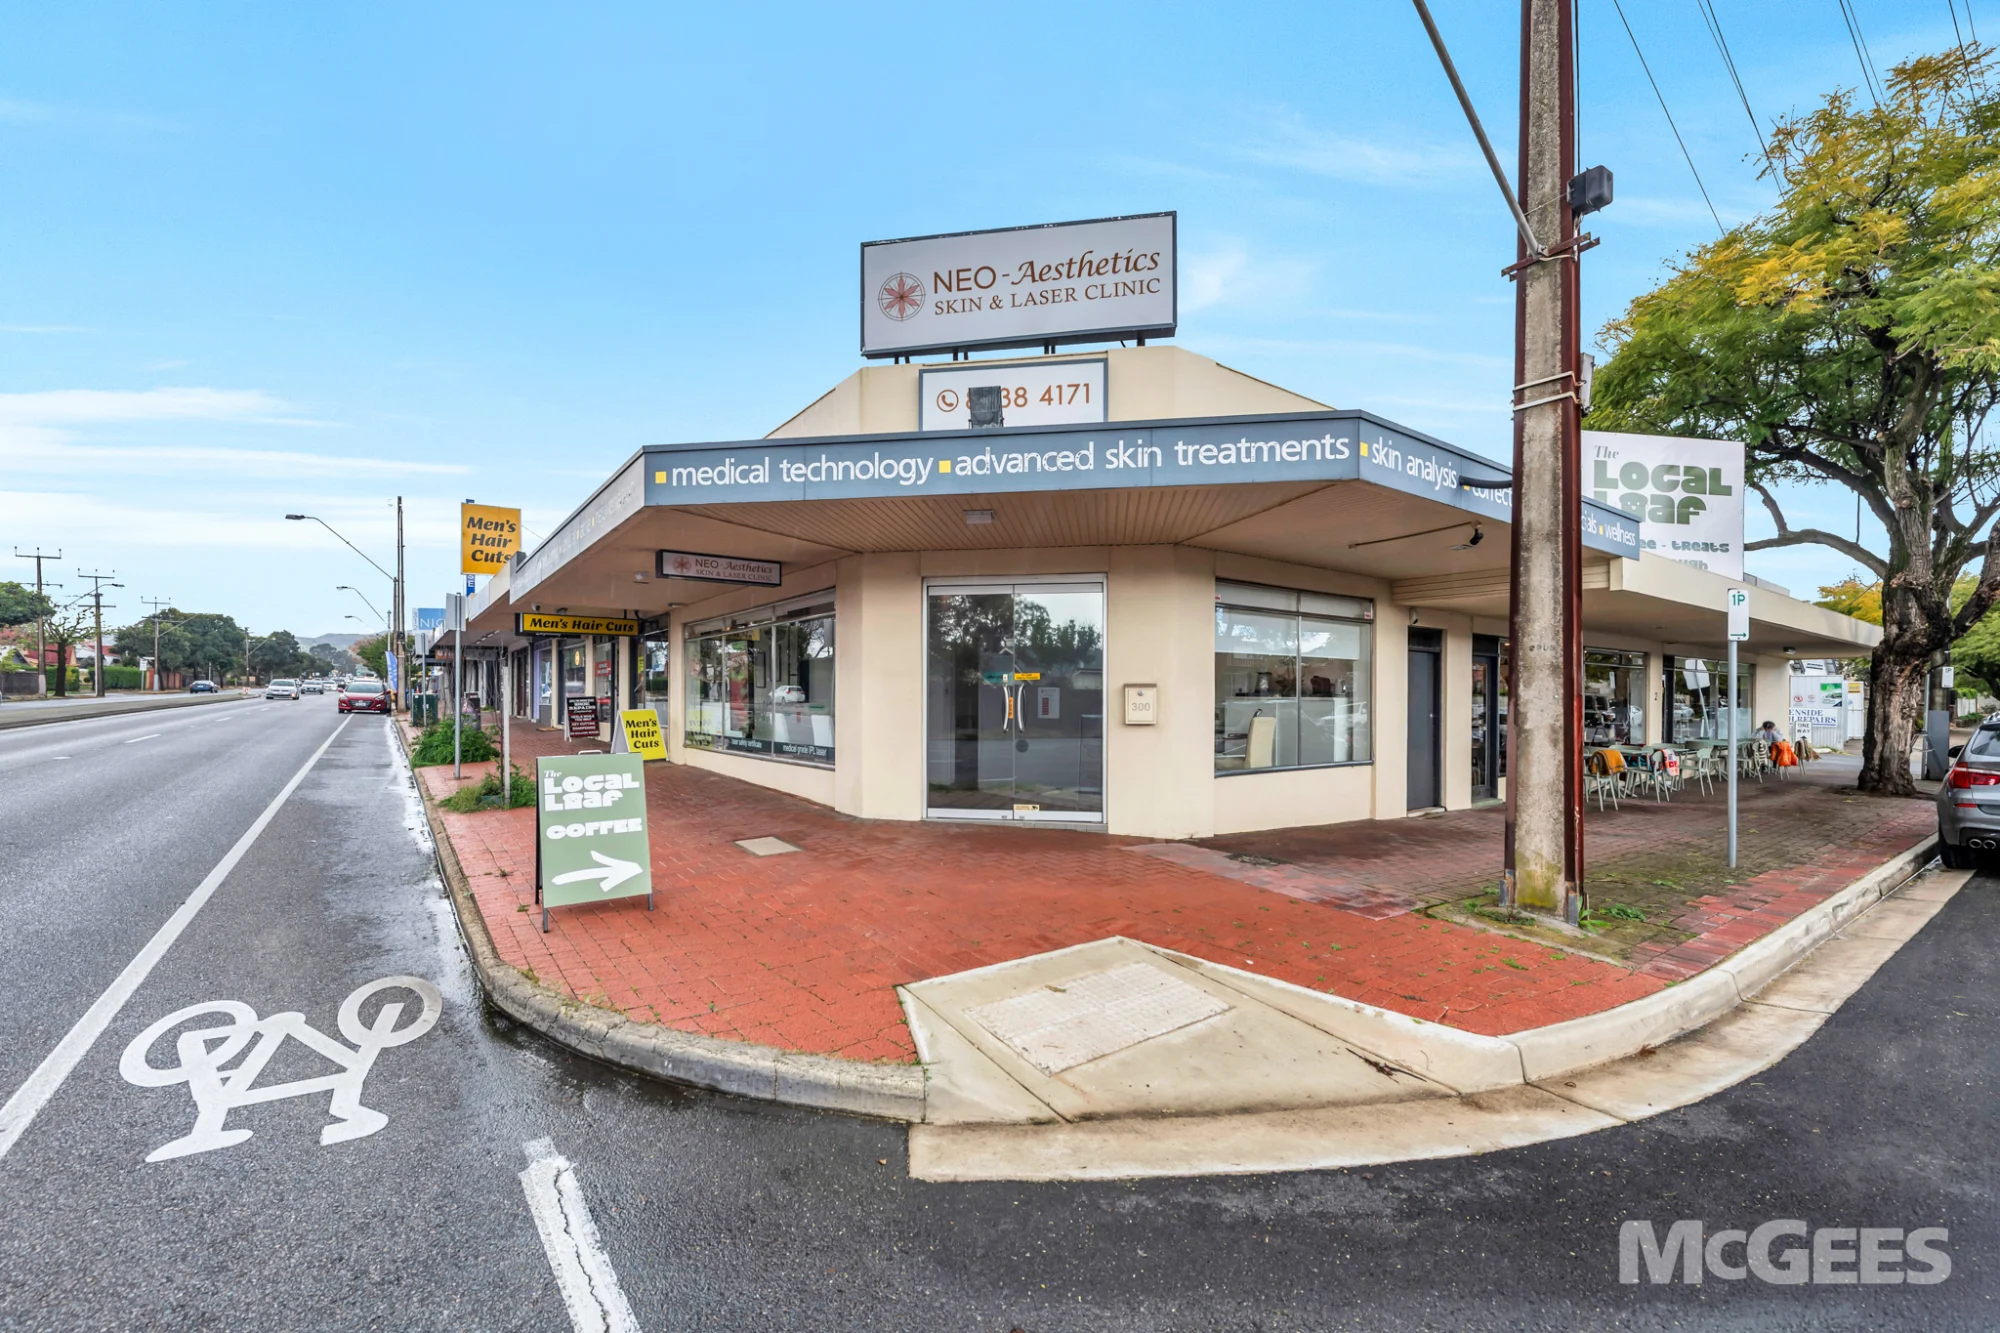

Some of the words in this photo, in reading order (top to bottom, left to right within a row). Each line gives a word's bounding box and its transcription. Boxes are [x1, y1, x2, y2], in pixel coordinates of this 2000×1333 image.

[934, 265, 997, 294] NEO
[1011, 248, 1161, 285] Aesthetics
[934, 296, 982, 315] SKIN
[989, 295, 1004, 310] &
[1010, 286, 1078, 308] LASER
[1084, 278, 1161, 300] CLINIC
[1039, 383, 1090, 405] 4171
[672, 456, 770, 486] medical
[779, 452, 934, 485] technology
[954, 441, 1094, 476] advanced
[1105, 438, 1162, 470] skin
[1174, 433, 1350, 466] treatments
[1594, 445, 1620, 459] The
[1371, 436, 1402, 471] skin
[1406, 455, 1458, 491] analysis
[467, 516, 516, 533] Men's
[471, 533, 512, 548] Hair
[1605, 522, 1636, 546] wellness
[471, 549, 513, 564] Cuts
[695, 558, 719, 568] NEO
[724, 561, 773, 574] Aesthetics
[723, 571, 747, 579] LASER
[748, 573, 773, 581] CLINIC
[1732, 594, 1746, 606] 1P
[530, 618, 568, 629] Men's
[572, 620, 602, 631] Hair
[606, 621, 634, 632] Cuts
[1131, 702, 1151, 711] 300
[625, 718, 658, 728] Men's
[631, 729, 658, 739] Hair
[633, 740, 659, 749] Cuts
[546, 817, 642, 839] COFFEE
